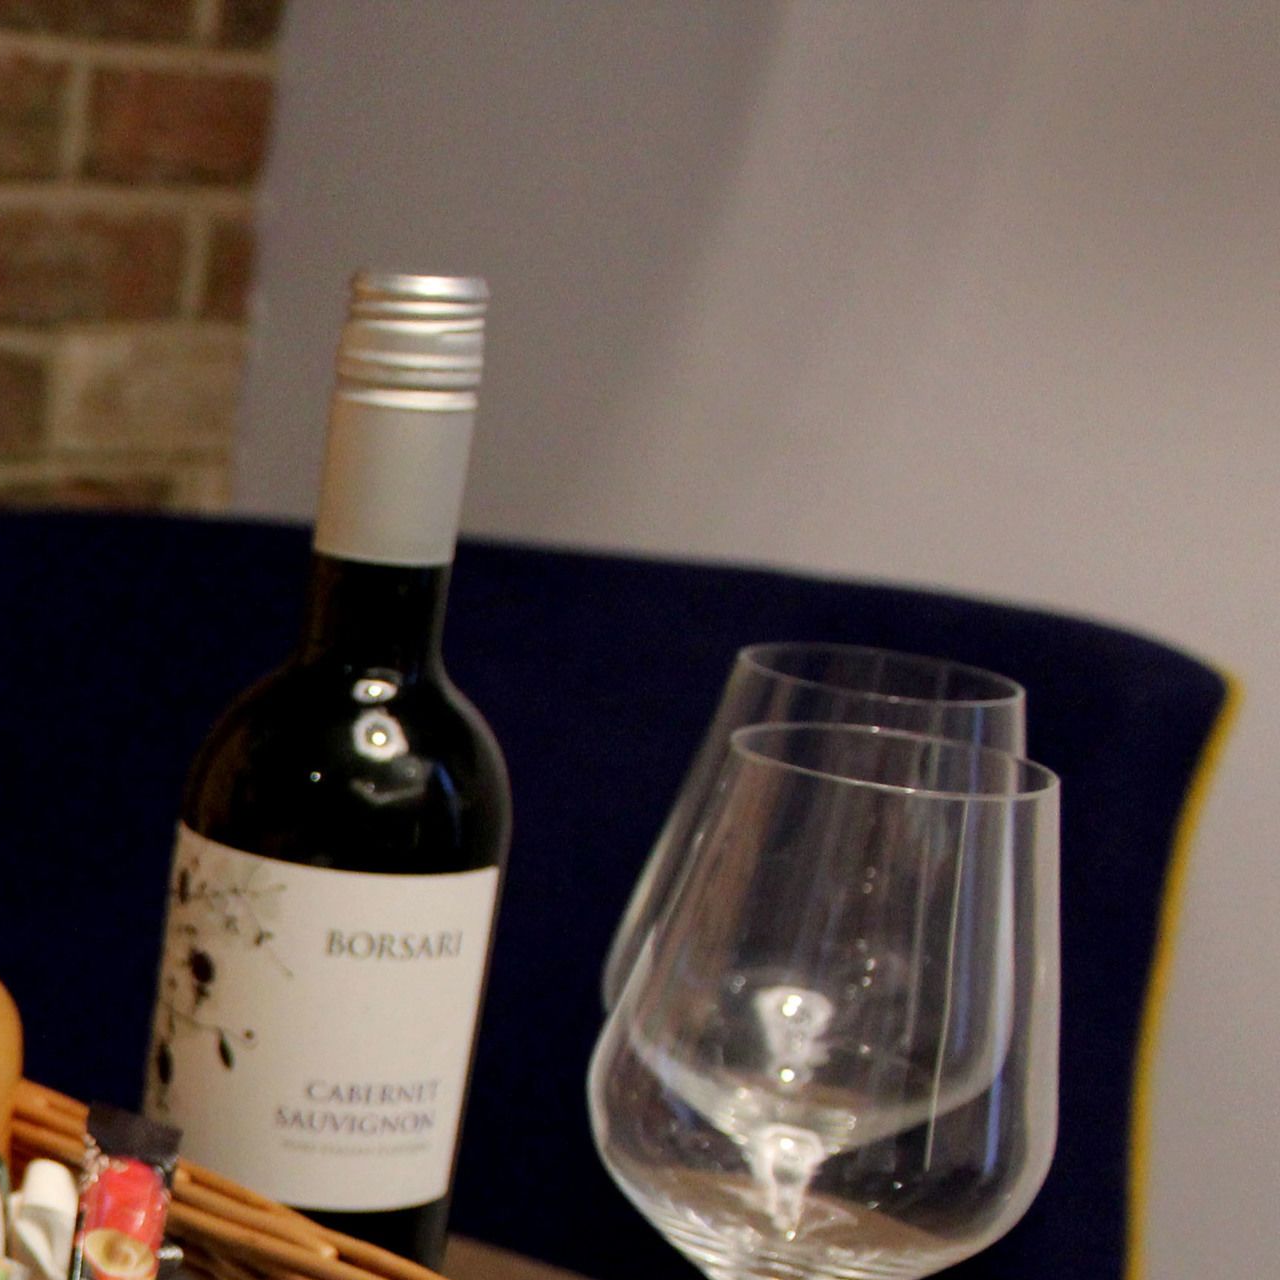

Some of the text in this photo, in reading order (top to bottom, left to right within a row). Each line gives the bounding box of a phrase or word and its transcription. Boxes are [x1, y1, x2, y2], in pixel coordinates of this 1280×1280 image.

[325, 928, 464, 960] BORSARI
[305, 1078, 441, 1105] CABERNET
[276, 1106, 436, 1135] SAUVIGNON
